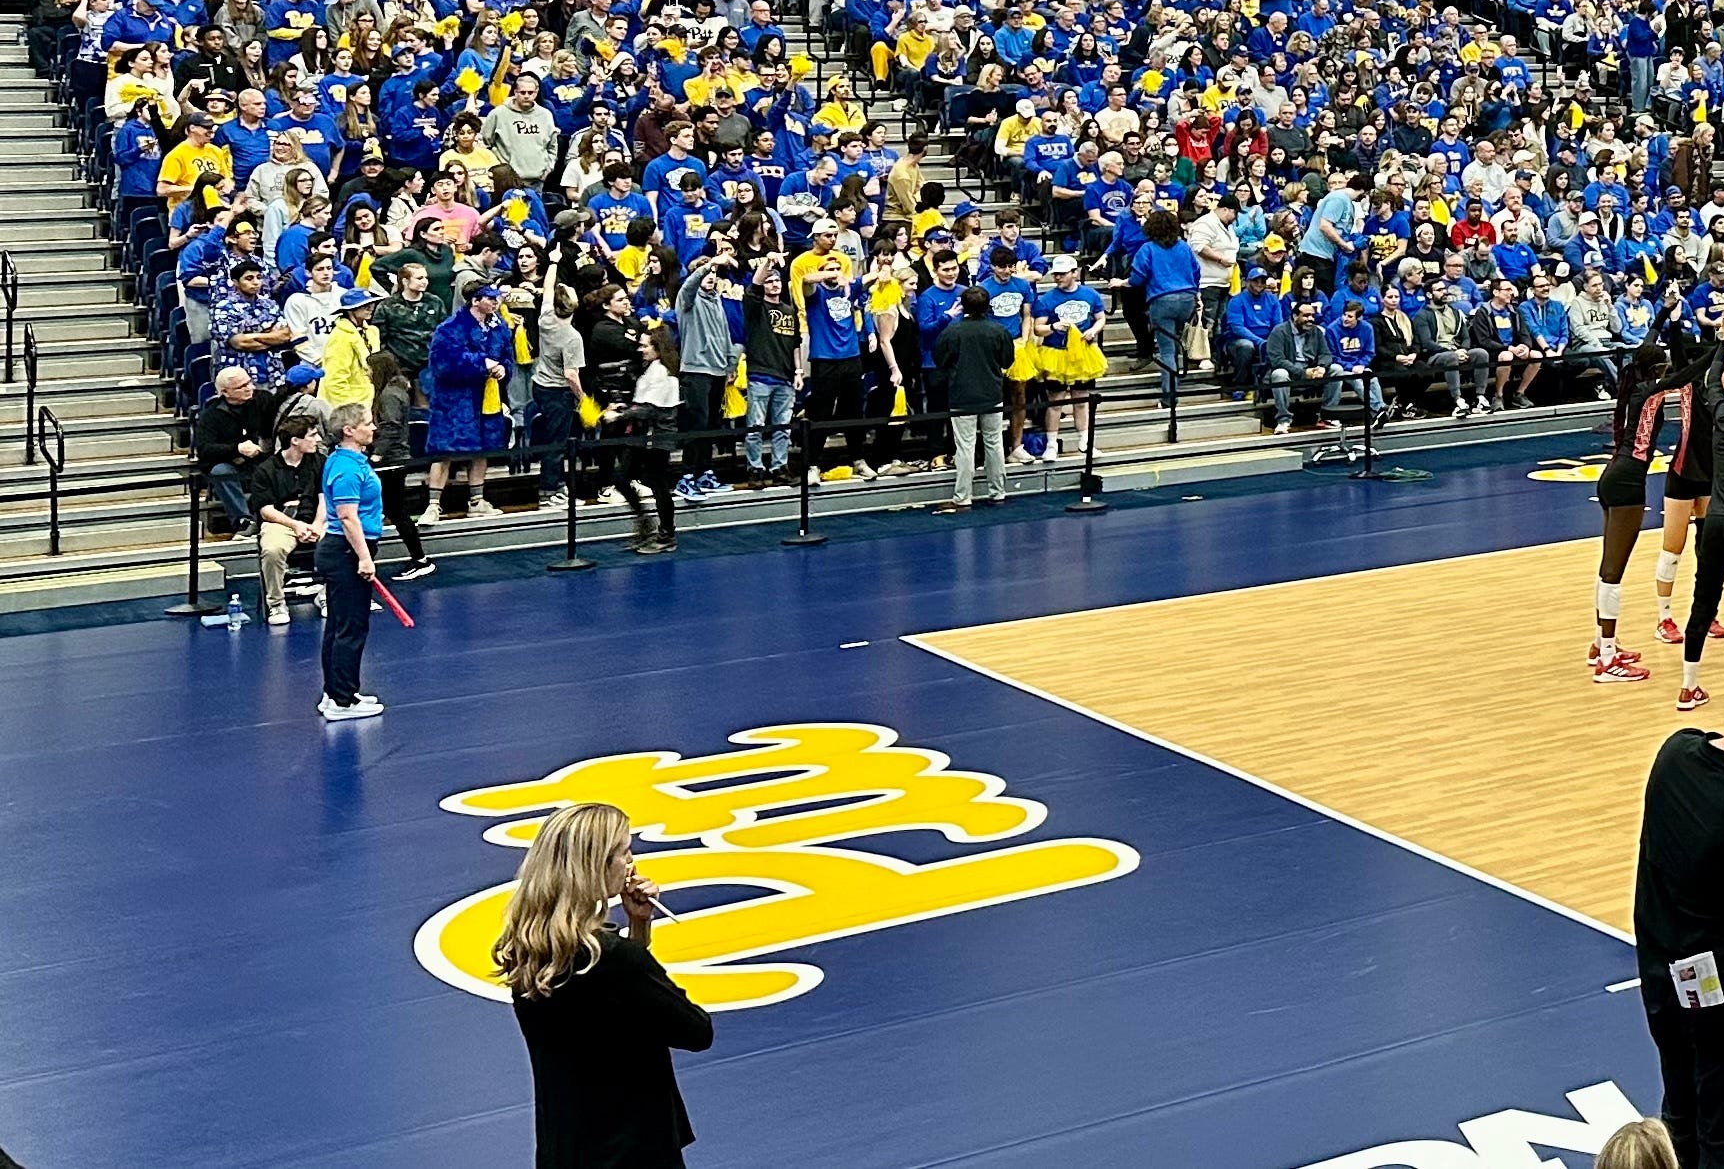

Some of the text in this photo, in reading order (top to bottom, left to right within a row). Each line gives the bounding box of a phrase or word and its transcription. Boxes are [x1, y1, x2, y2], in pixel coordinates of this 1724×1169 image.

[688, 27, 714, 40] Pitt
[512, 120, 540, 134] Pitt
[192, 158, 216, 172] Pitt
[309, 316, 336, 335] Pit
